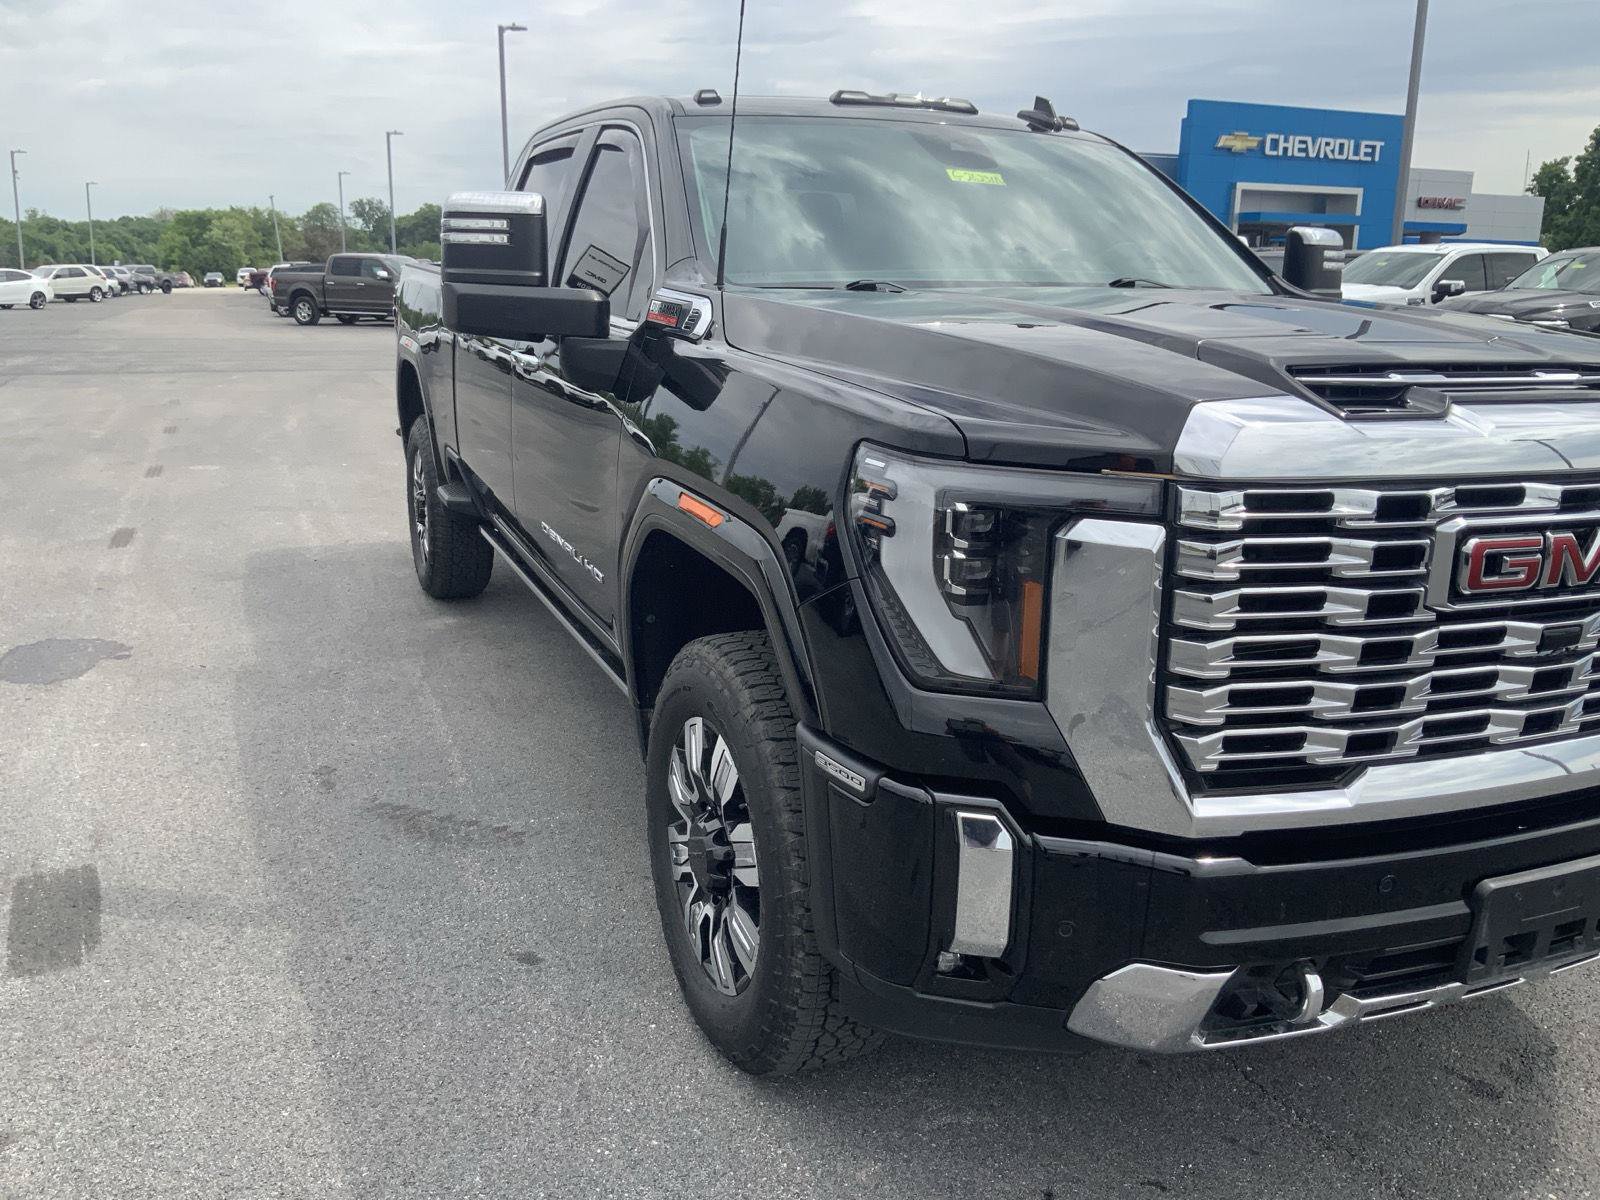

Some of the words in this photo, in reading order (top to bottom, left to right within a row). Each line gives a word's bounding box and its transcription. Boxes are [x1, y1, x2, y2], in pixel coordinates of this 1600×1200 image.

[1265, 134, 1384, 161] CHEVROLET
[541, 521, 583, 566] DENALI
[583, 559, 604, 584] HD
